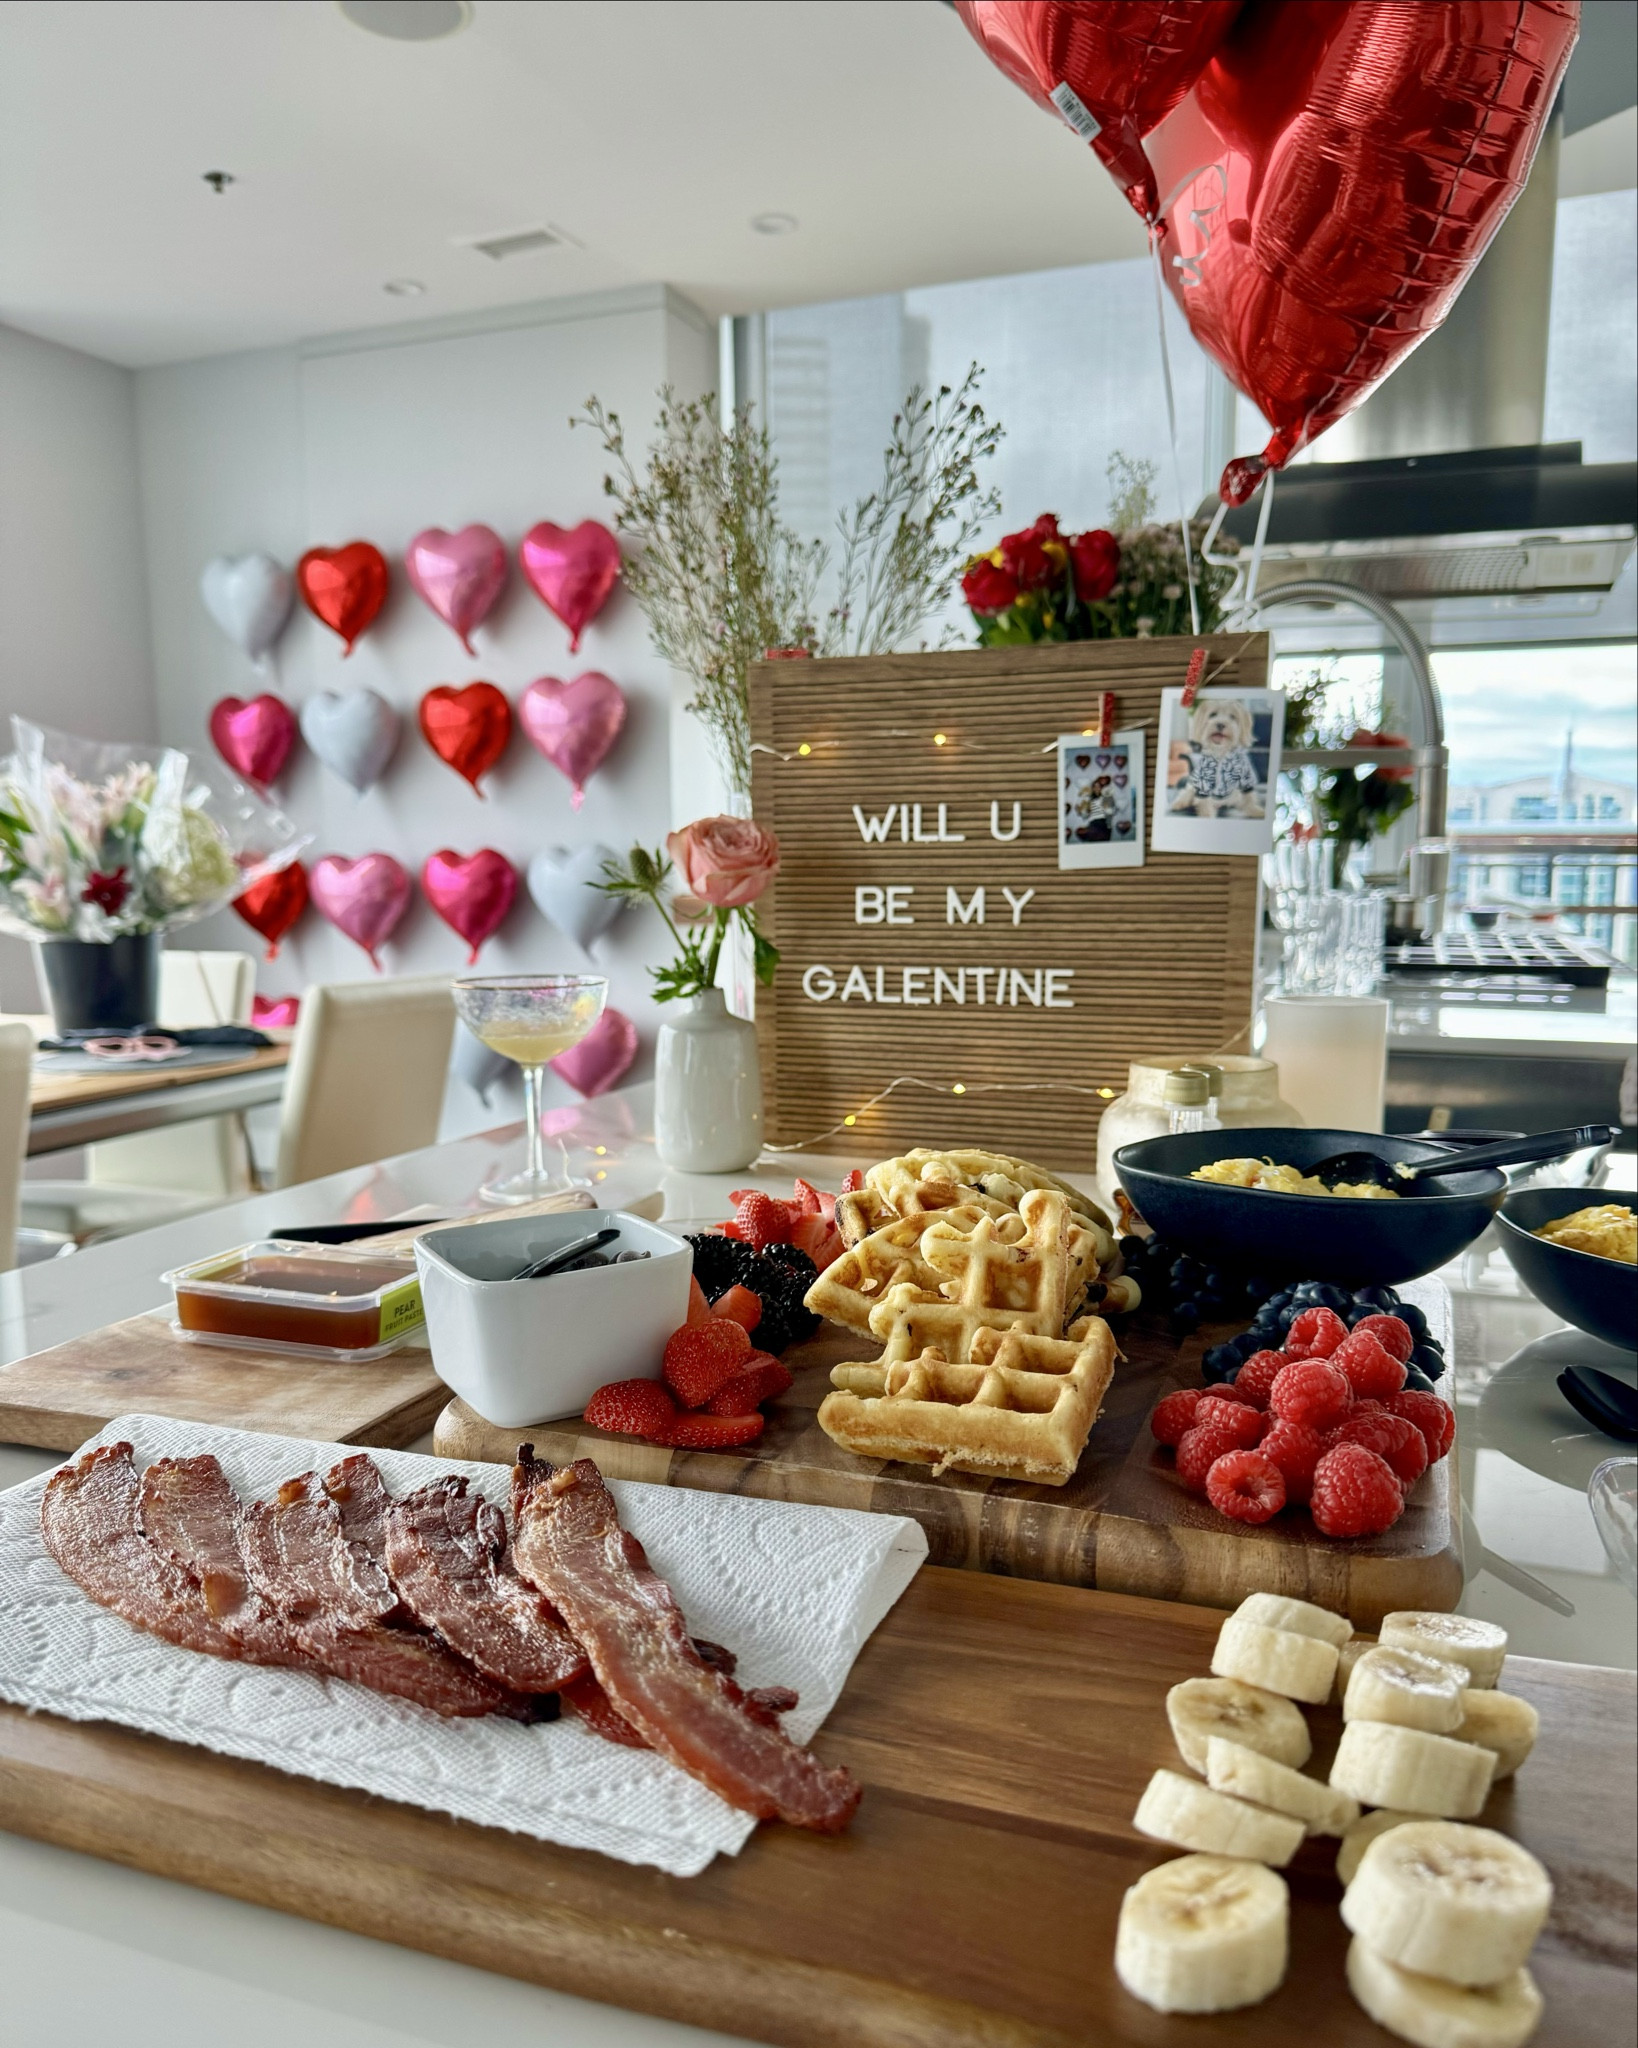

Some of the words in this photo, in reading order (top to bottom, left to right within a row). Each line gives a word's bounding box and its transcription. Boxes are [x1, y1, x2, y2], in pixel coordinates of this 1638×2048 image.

[852, 803, 966, 843] WILL
[989, 801, 1022, 842] U
[855, 886, 915, 925] BE
[946, 886, 1036, 926] MY
[802, 964, 1075, 1008] GALENTINE
[385, 1317, 404, 1332] FRUIT
[394, 1299, 416, 1318] PEAR
